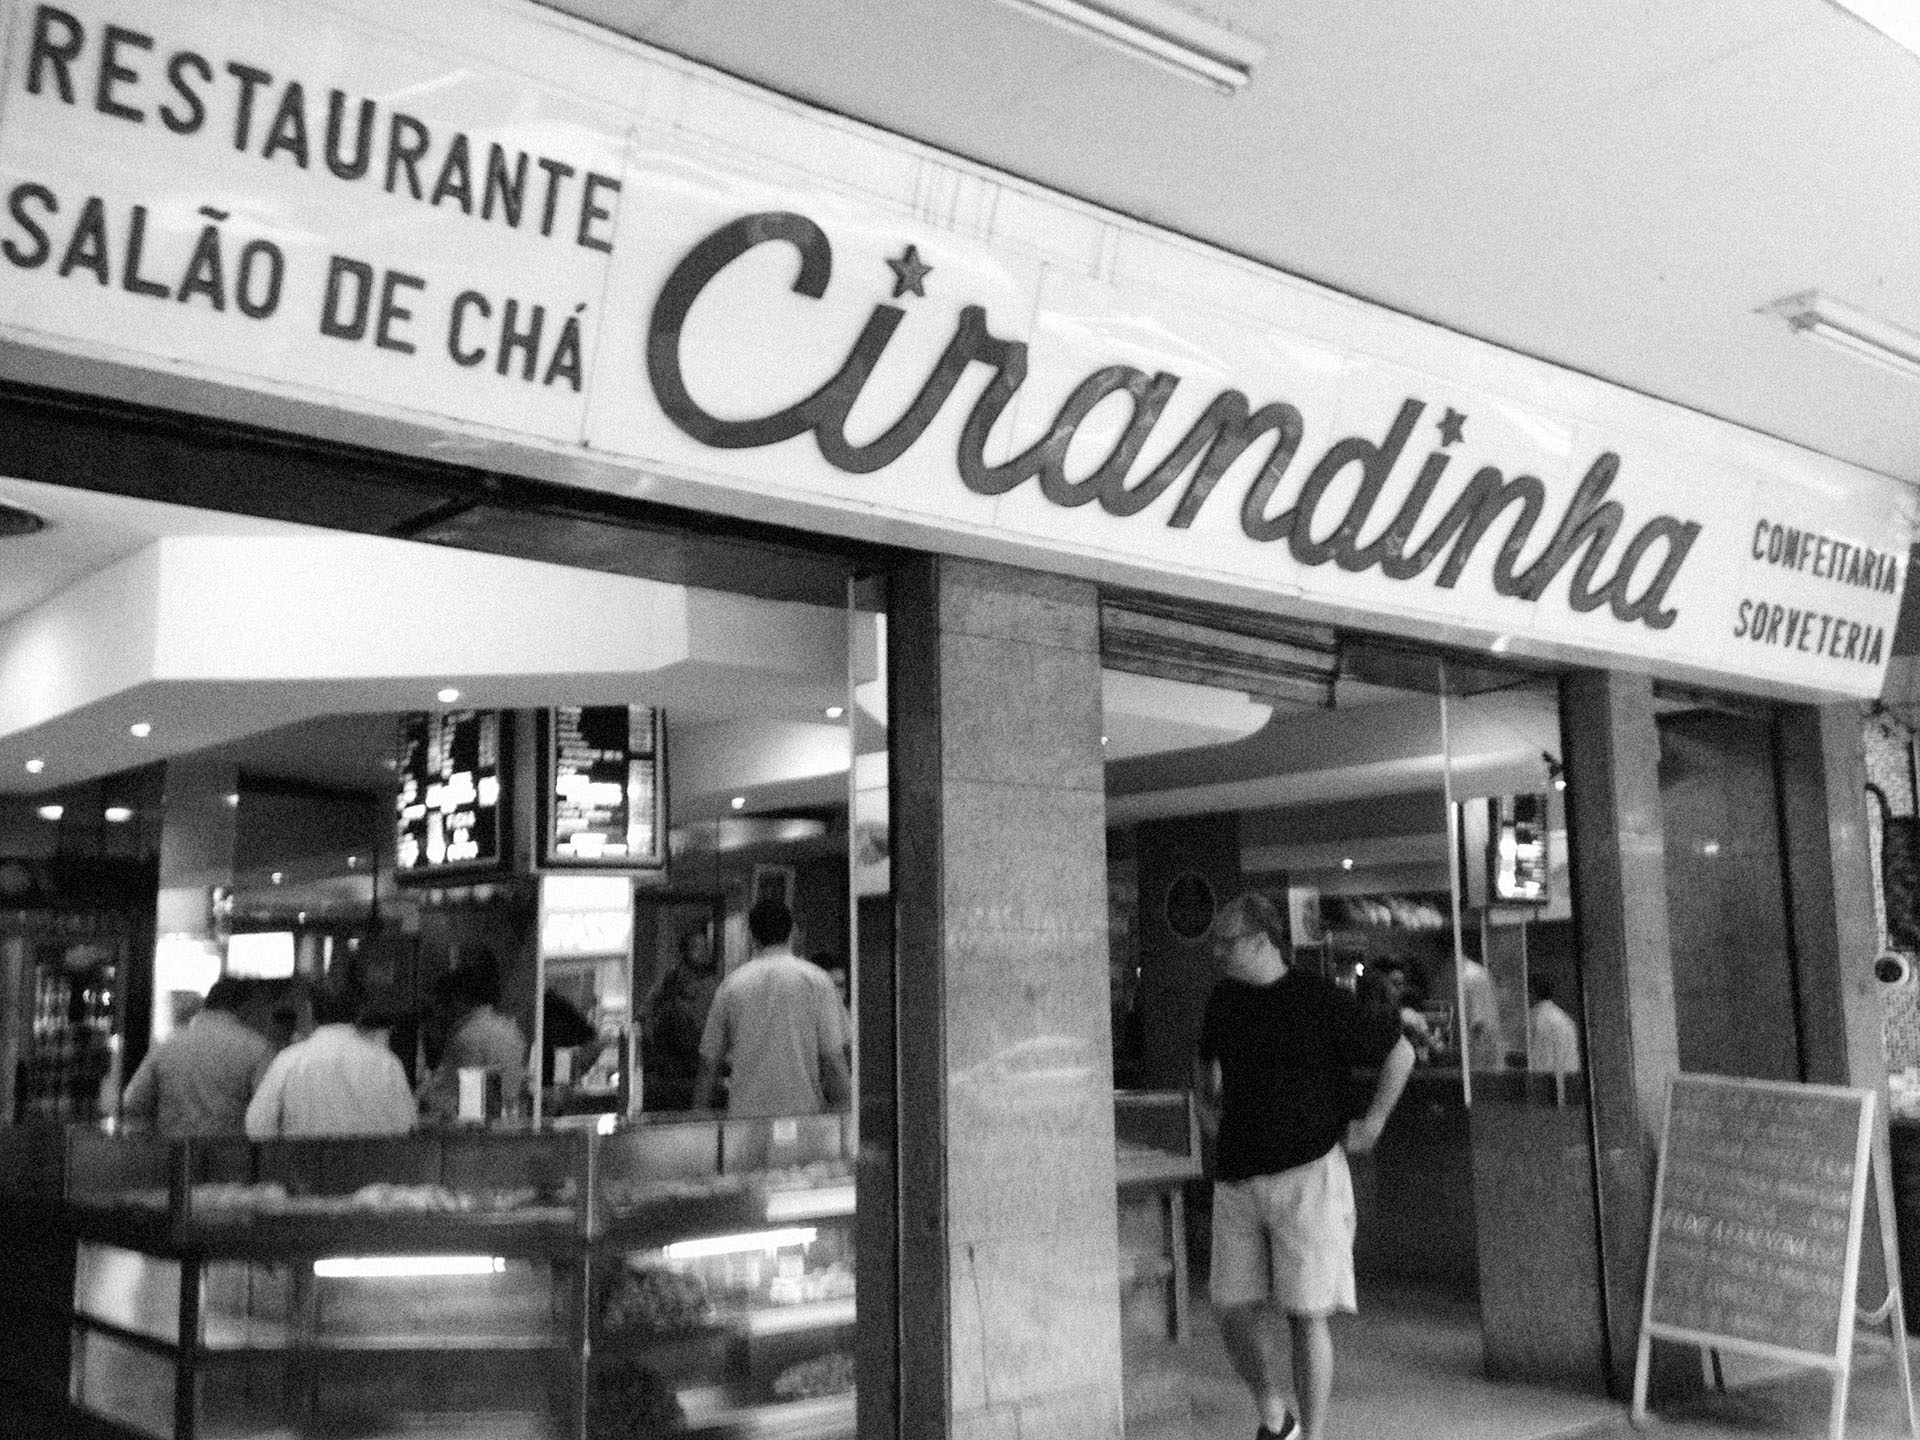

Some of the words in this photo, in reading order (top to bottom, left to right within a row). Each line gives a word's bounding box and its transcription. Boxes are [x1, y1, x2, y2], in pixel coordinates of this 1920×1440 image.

[26, 5, 623, 253] RESTAURANTE
[2, 183, 286, 319] SALÃO
[320, 255, 426, 355] DE
[447, 291, 589, 393] CHÁ
[646, 211, 1703, 630] Cirandinha
[1734, 600, 1883, 665] SORVETERIA
[1752, 519, 1897, 594] CONFEITARIA
